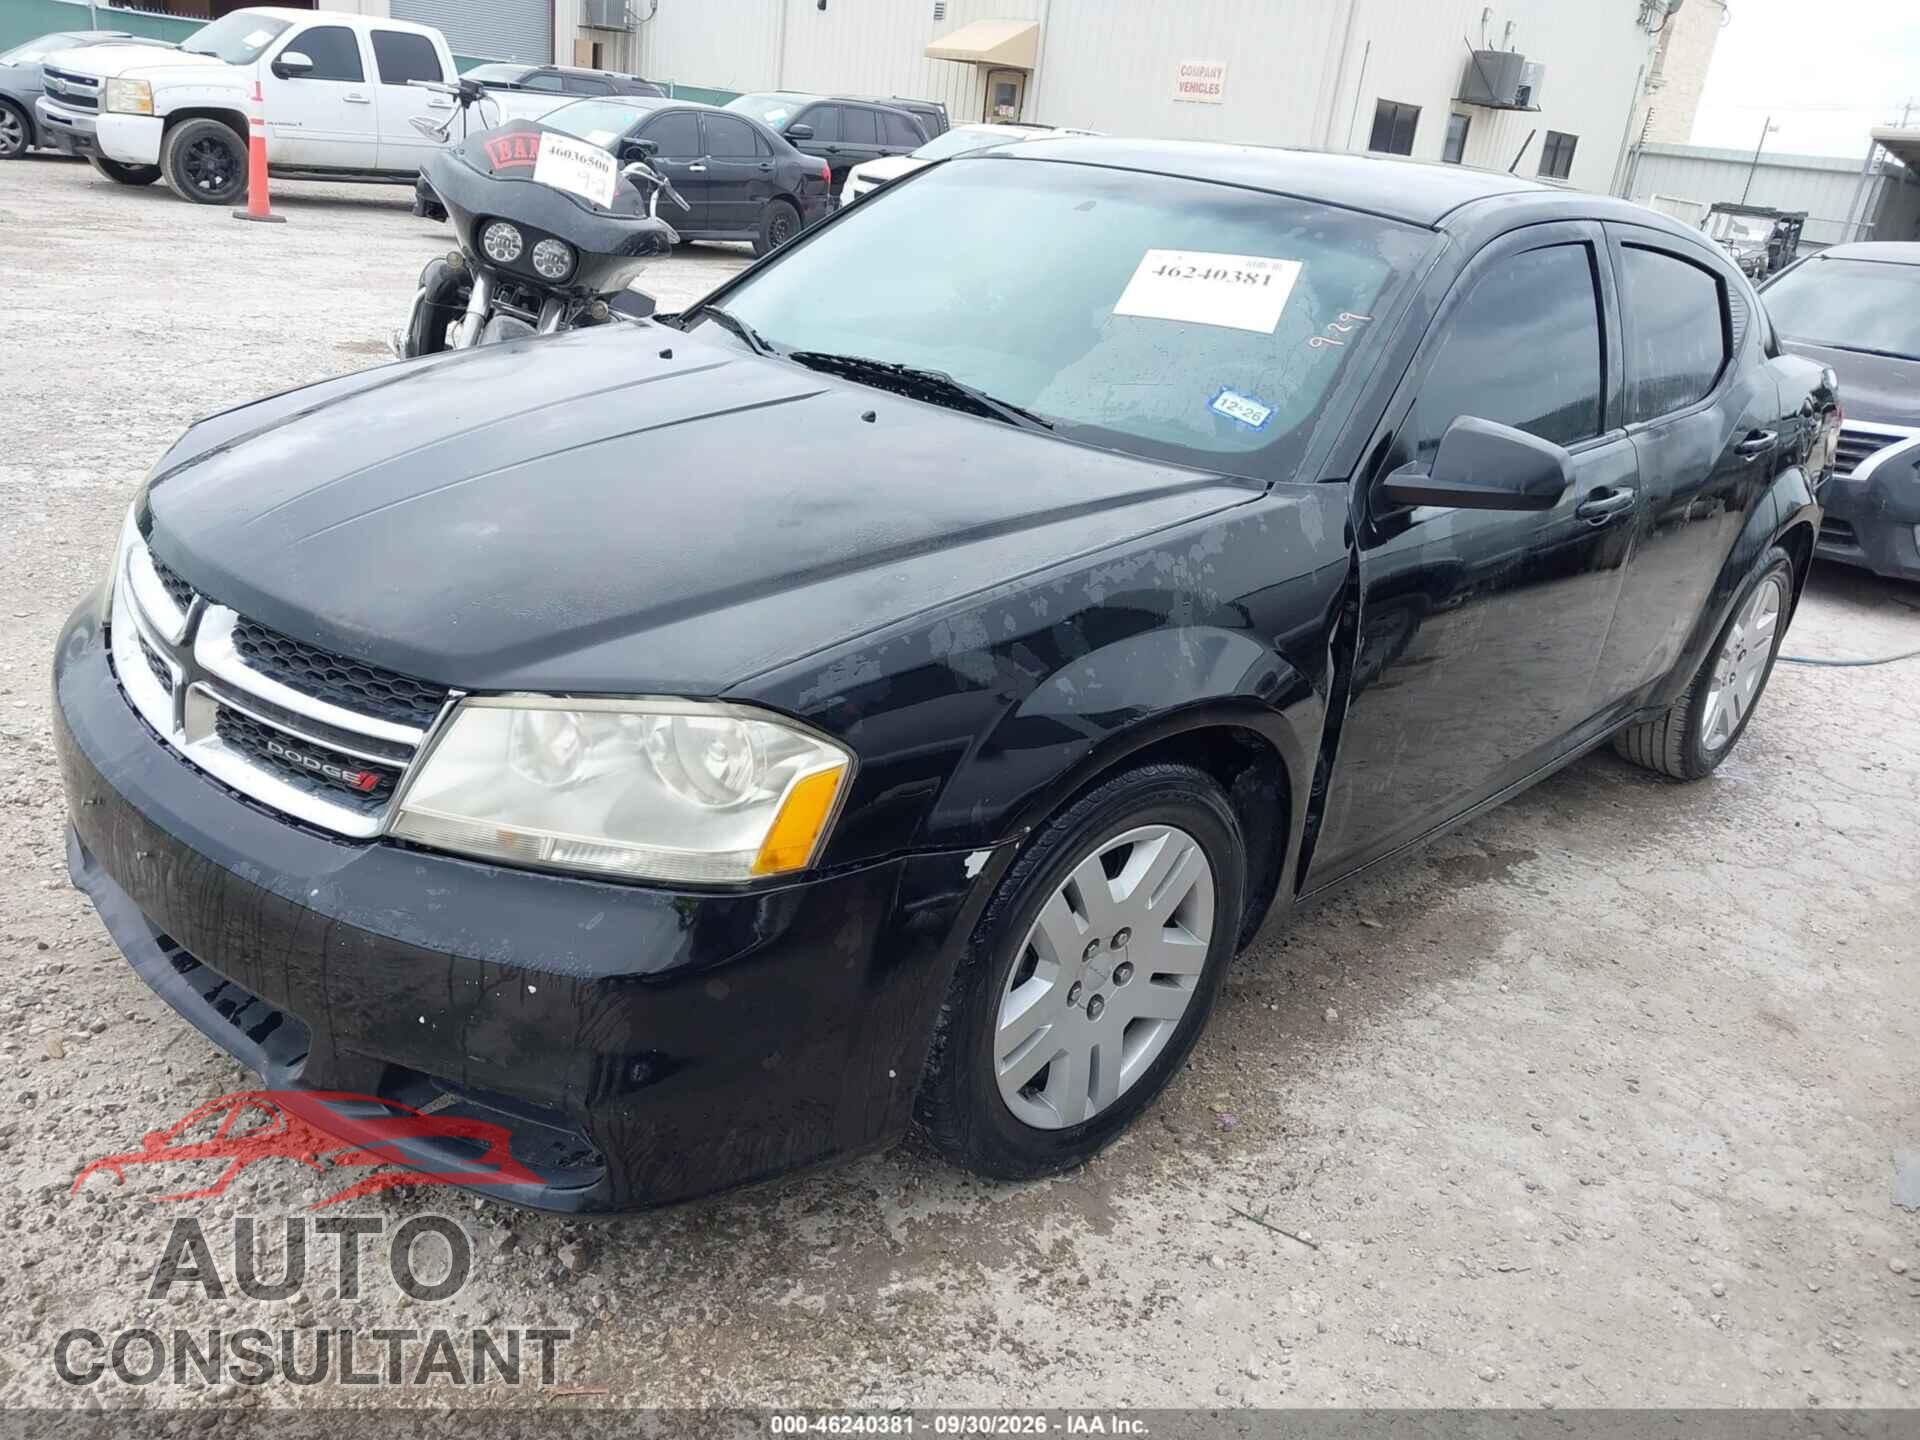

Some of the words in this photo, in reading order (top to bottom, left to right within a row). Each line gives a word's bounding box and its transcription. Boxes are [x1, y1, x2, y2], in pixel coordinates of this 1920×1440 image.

[1180, 64, 1223, 78] COMPANY
[1179, 81, 1221, 95] VEHICLES
[549, 145, 609, 174] 46036500
[1152, 264, 1272, 287] 46240381
[267, 740, 361, 785] DODGE
